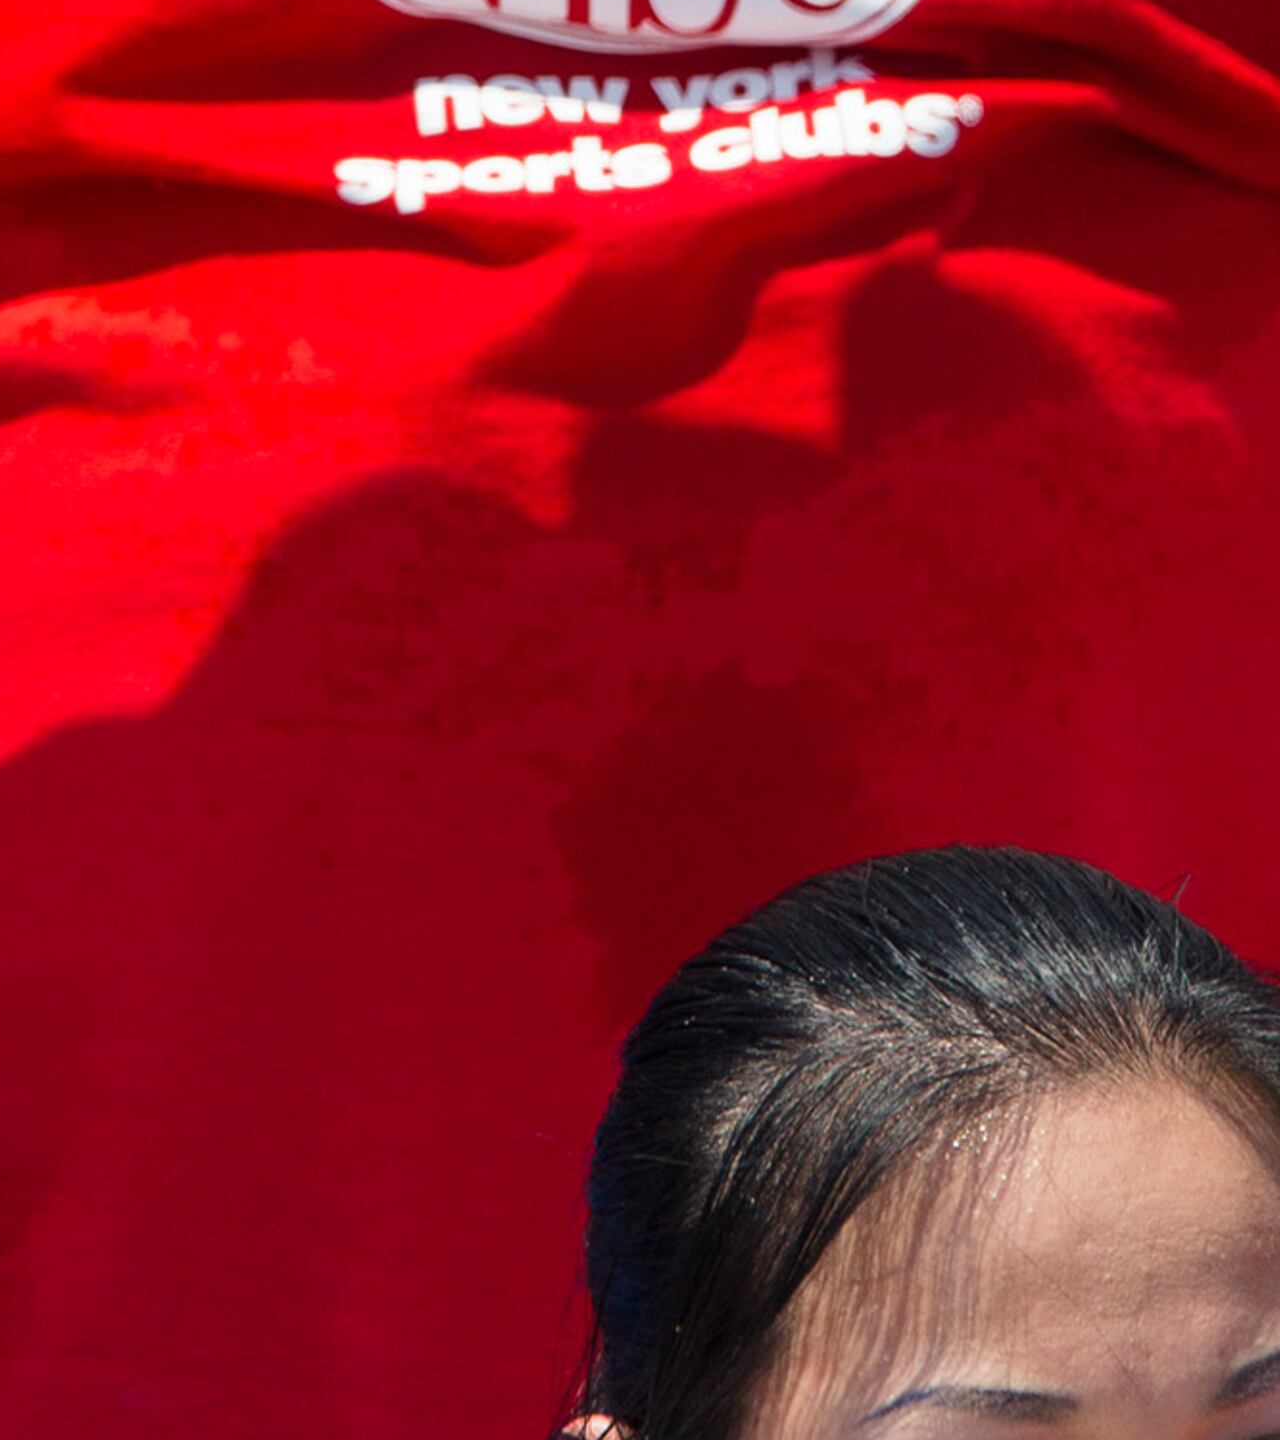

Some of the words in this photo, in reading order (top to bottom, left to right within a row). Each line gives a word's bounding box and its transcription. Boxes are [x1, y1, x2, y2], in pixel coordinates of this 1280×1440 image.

[412, 72, 630, 137] new
[651, 47, 876, 133] york
[333, 134, 673, 215] sports
[688, 87, 960, 159] clubs
